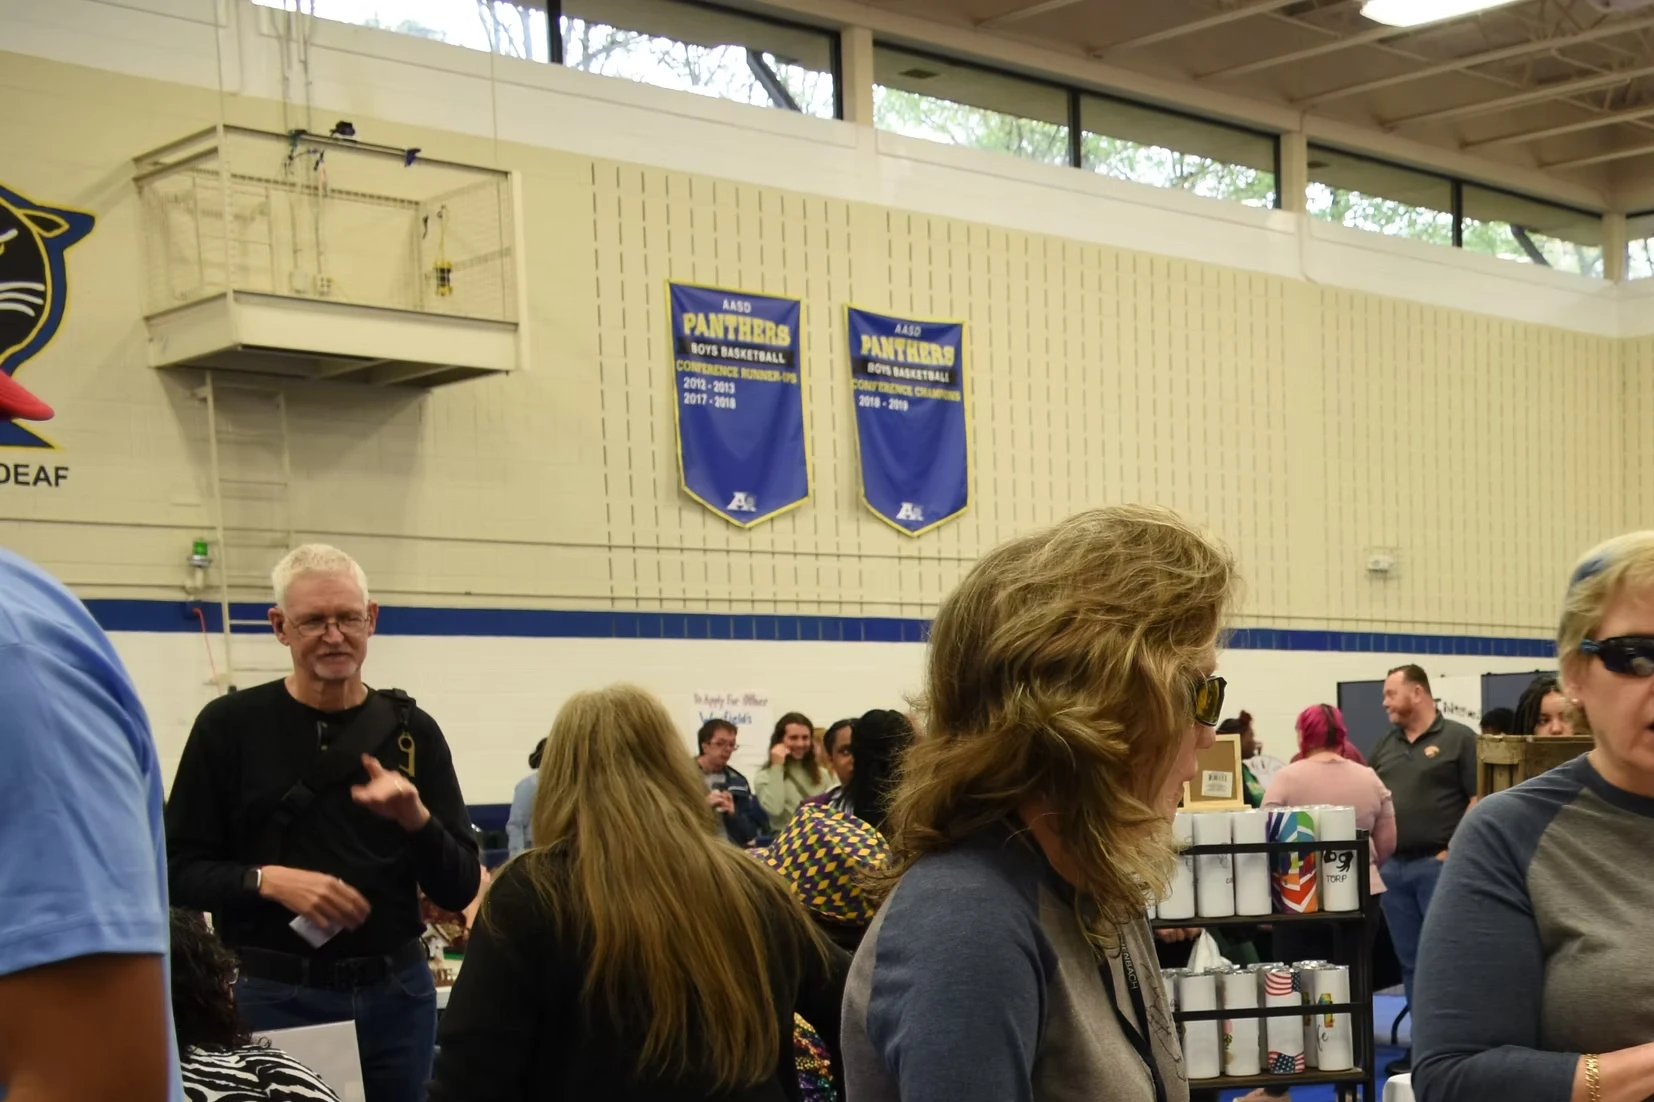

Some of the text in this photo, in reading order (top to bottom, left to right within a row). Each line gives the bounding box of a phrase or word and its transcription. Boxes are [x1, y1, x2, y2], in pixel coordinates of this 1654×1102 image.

[722, 298, 752, 313] AASD
[683, 311, 791, 347] PANTHERS
[894, 322, 922, 338] AASD
[691, 342, 786, 364] BOYS BASKETBALL
[861, 334, 955, 367] PANTHERS
[676, 359, 739, 379] CONFERENCE
[867, 361, 950, 383] BOYS BASKETBALL
[684, 377, 706, 391] 2012
[683, 391, 707, 405] 2017
